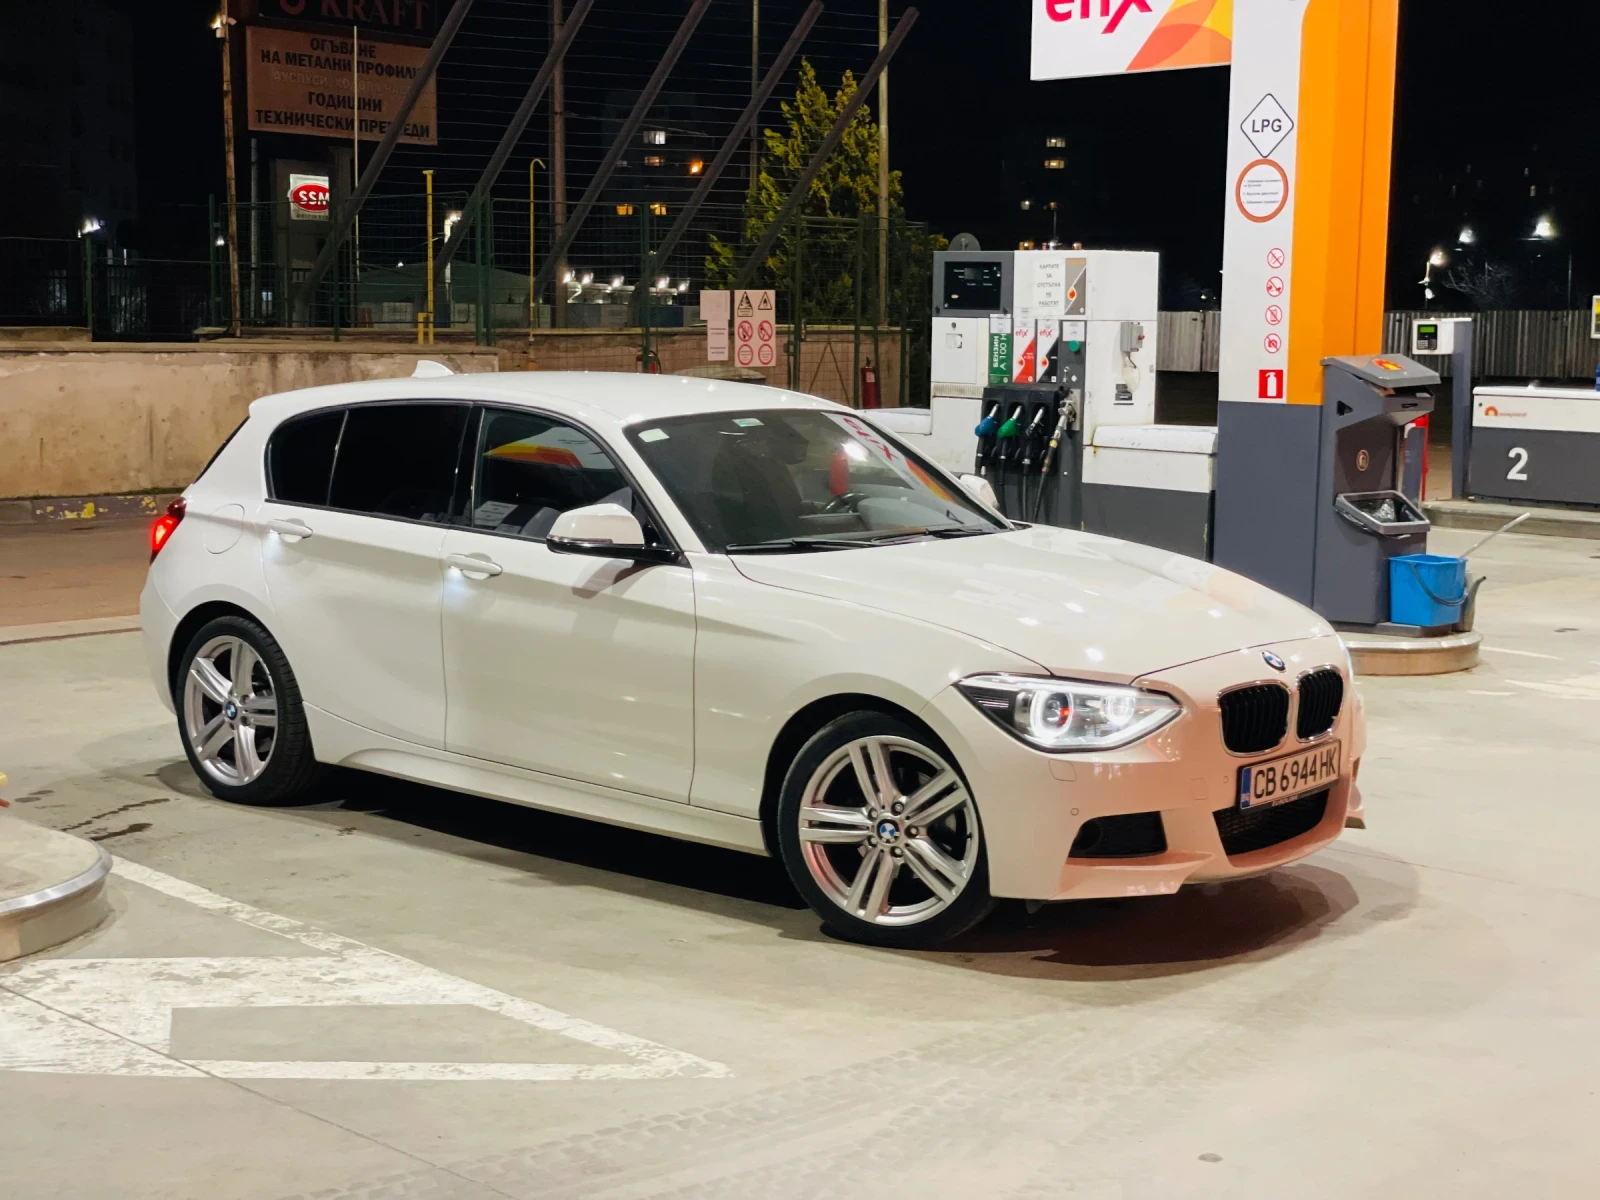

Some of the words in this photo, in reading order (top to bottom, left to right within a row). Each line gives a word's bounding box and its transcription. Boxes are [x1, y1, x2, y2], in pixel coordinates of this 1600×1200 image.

[261, 50, 281, 64] НА
[285, 53, 350, 73] МЕТАЛНИ
[307, 91, 382, 113] ГОДИШНИ
[256, 109, 355, 131] ТЕХНИЧЕСКИ
[358, 119, 430, 141] ПРЕЕДИ
[1251, 118, 1282, 133] LPG
[999, 342, 1007, 358] 100
[1506, 447, 1529, 481] 2
[1254, 767, 1276, 798] CB
[1279, 755, 1317, 791] 6944
[1319, 747, 1337, 781] HK
